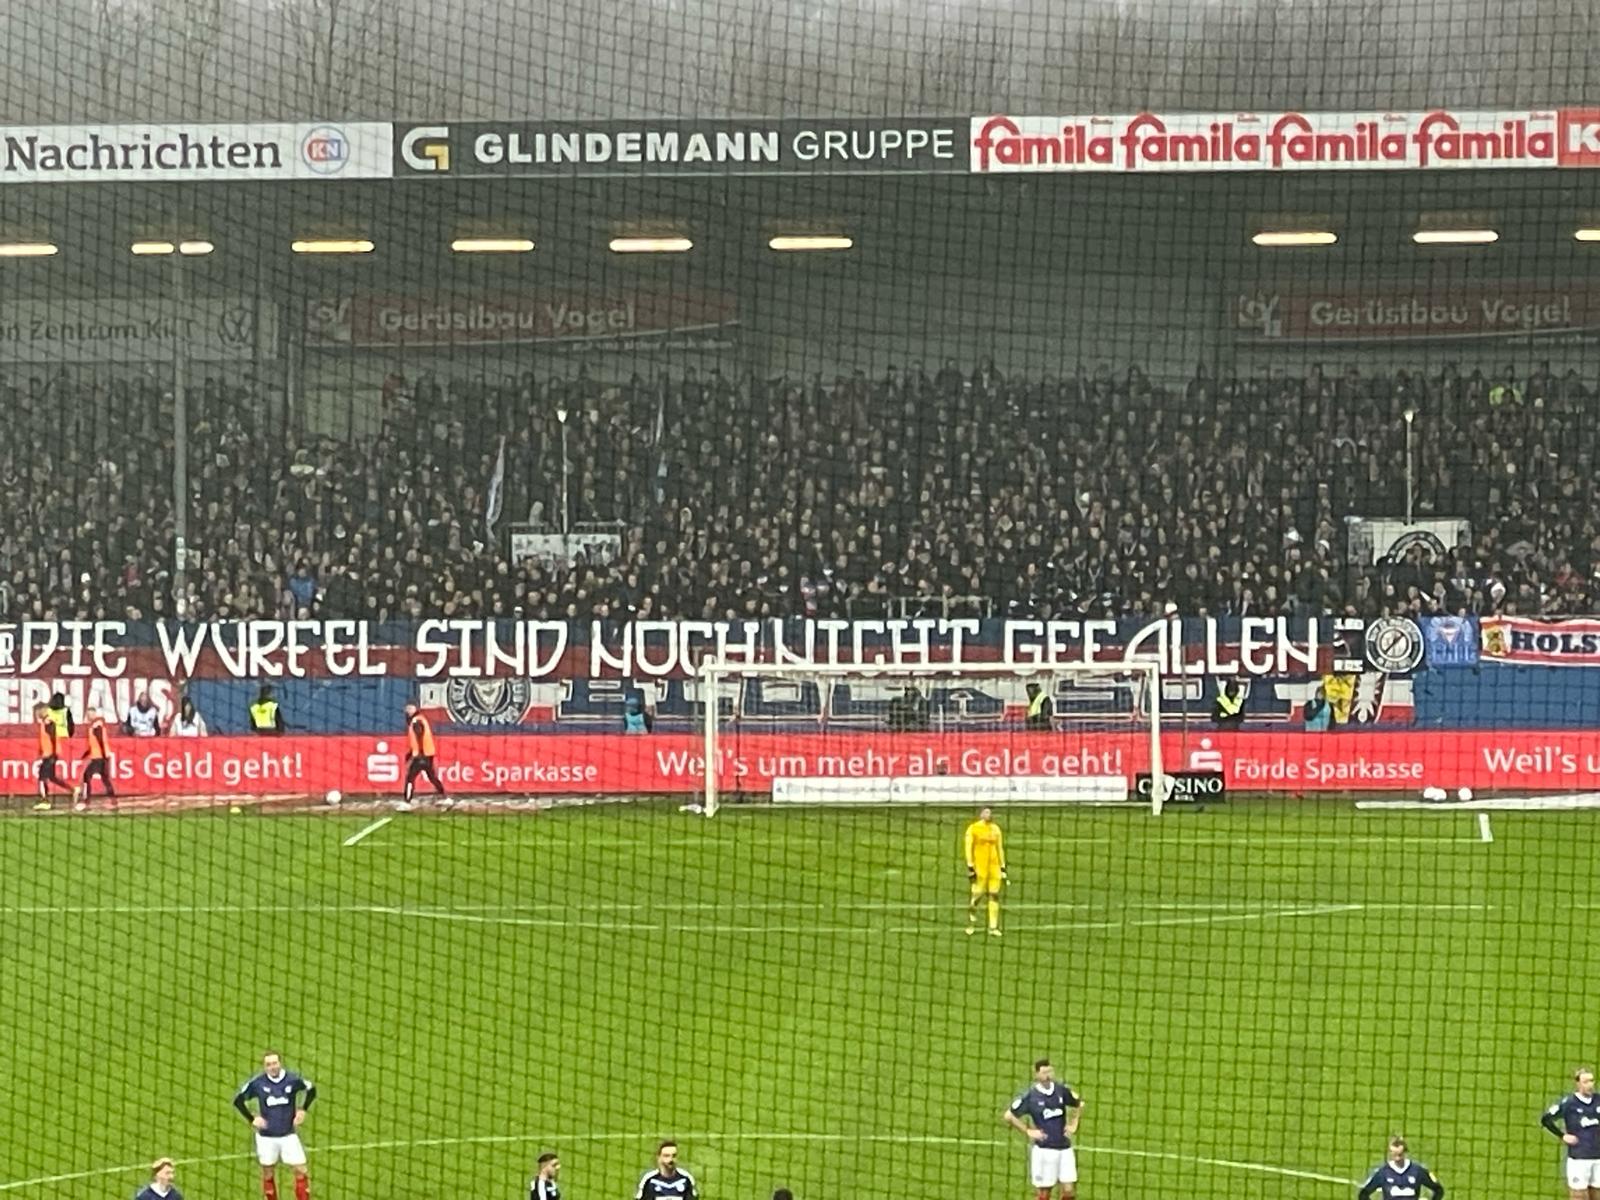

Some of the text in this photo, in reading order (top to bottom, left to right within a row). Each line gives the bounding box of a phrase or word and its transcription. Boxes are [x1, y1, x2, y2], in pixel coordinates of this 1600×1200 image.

[4, 134, 282, 172] Nachrichten
[474, 129, 955, 164] GLINDEMANN GRUPPE
[974, 111, 1554, 171] famila famila famila famila
[379, 306, 534, 330] Gerüstbau
[546, 303, 635, 336] Vogel
[1310, 299, 1467, 326] Gerüstbau
[1482, 296, 1572, 328] Vogel
[30, 319, 139, 341] Zentrum
[21, 620, 128, 677] DIE
[416, 619, 568, 677] SIND
[591, 619, 760, 677] NOCH
[774, 618, 980, 677] NICHT
[1004, 616, 1318, 677] GEFALLEN
[1511, 630, 1600, 654] HOLS
[143, 752, 212, 779] Geld
[222, 752, 303, 785] geht!
[481, 761, 597, 785] Sparkasse
[656, 750, 749, 777] Wel's
[758, 756, 807, 777] um
[817, 750, 899, 776] mehr
[961, 748, 1031, 775] Geld
[1042, 749, 1123, 776] geht!
[1234, 757, 1424, 783] Förde Sparkasse
[1483, 746, 1577, 774] Weil's
[1138, 778, 1223, 794] CSINO
